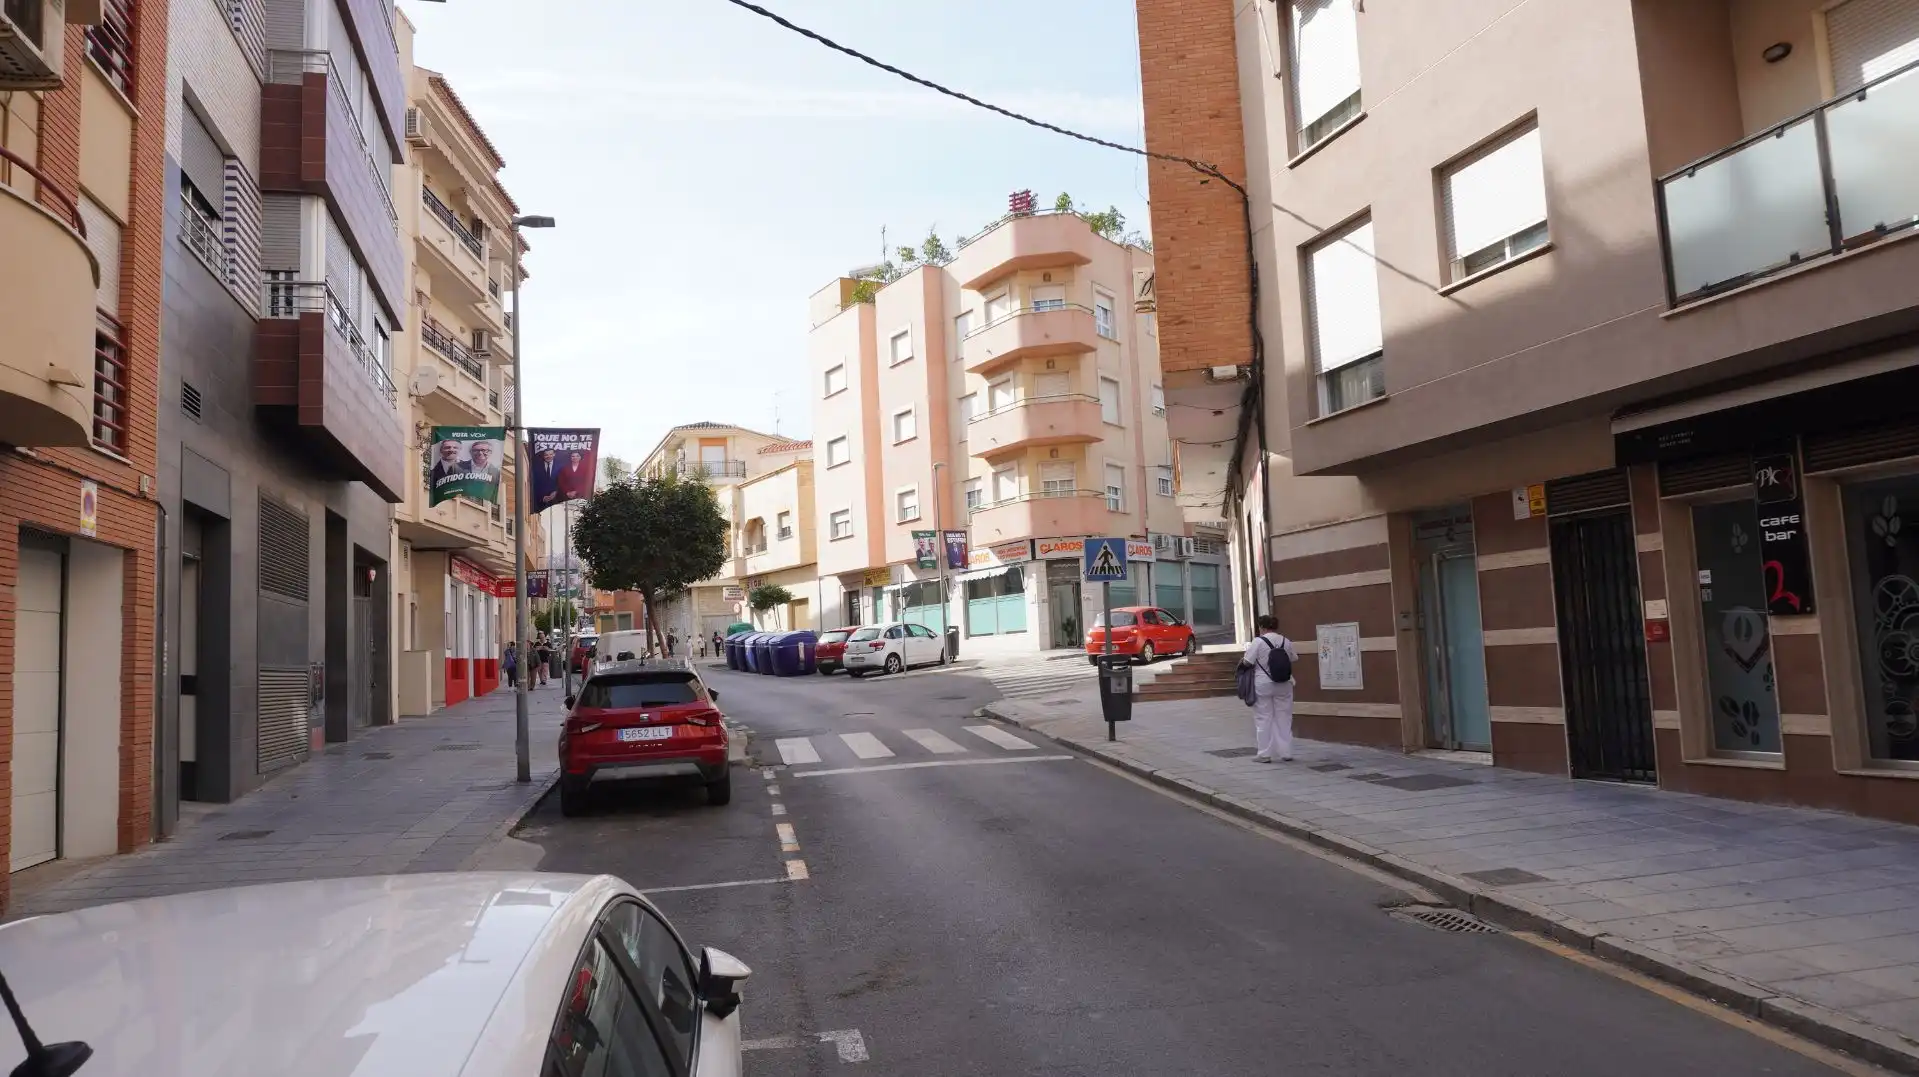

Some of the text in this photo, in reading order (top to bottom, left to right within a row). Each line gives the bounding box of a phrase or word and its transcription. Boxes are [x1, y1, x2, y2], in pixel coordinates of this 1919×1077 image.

[534, 441, 592, 454] ESTAFEN!
[436, 473, 464, 488] SENTIDO
[1765, 531, 1796, 541] bar
[1039, 541, 1084, 555] CLAROS
[1127, 543, 1153, 557] CLAROS
[625, 728, 669, 738] 5652 LLT
